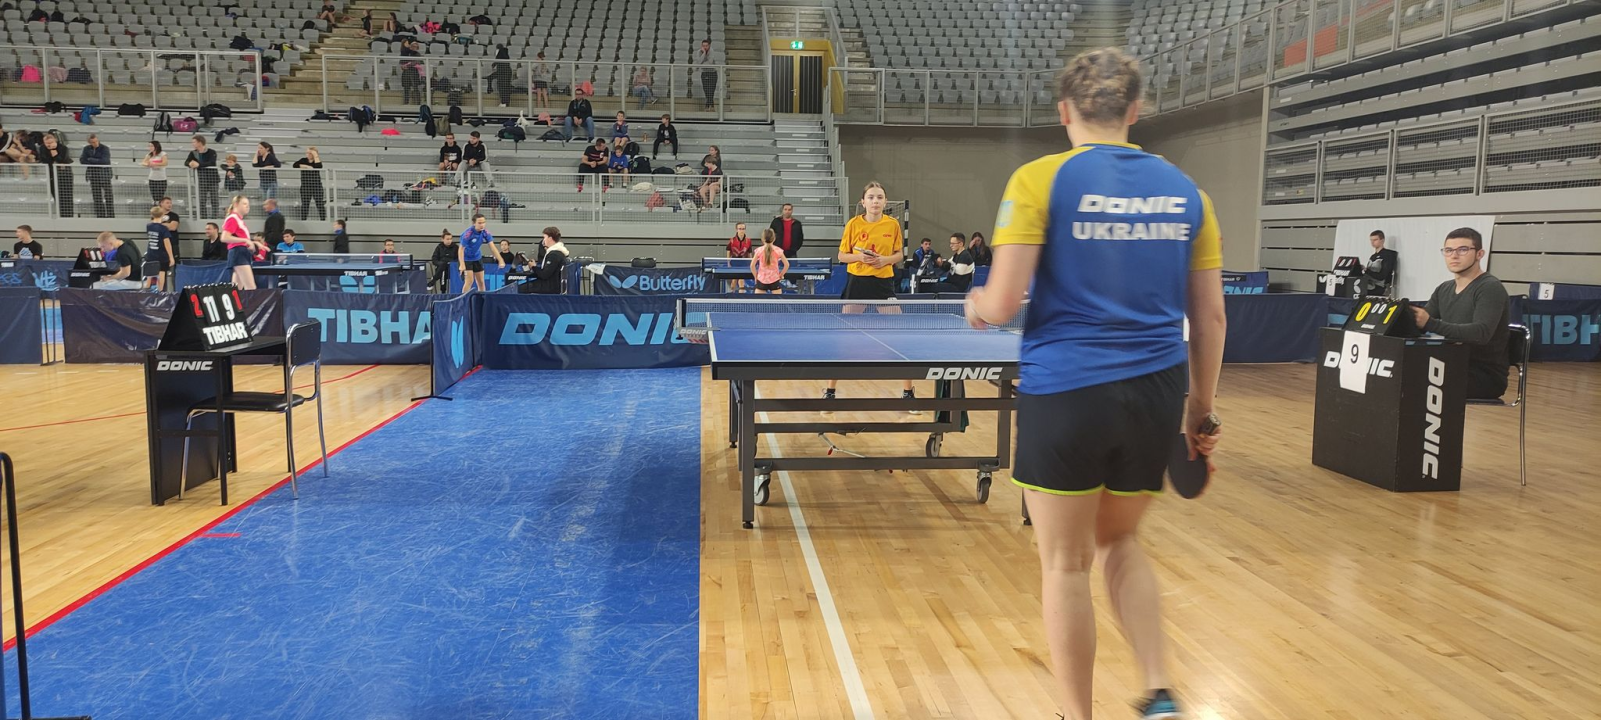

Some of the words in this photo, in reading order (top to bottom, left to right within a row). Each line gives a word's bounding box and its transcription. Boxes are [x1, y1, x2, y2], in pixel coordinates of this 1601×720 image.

[1077, 194, 1188, 214] DONIC
[1072, 221, 1192, 241] UKRAINE
[639, 274, 706, 291] Butterfly
[1543, 289, 1550, 299] 5
[190, 293, 204, 317] 2
[221, 293, 236, 321] 9
[1355, 302, 1372, 322] 0
[1382, 304, 1398, 325] 1
[202, 321, 249, 346] TIBHAR
[1323, 350, 1396, 377] DIC
[1350, 343, 1360, 365] 9
[156, 361, 213, 371] DONIC
[924, 367, 1004, 380] DONIC
[1422, 356, 1446, 480] DONIC
